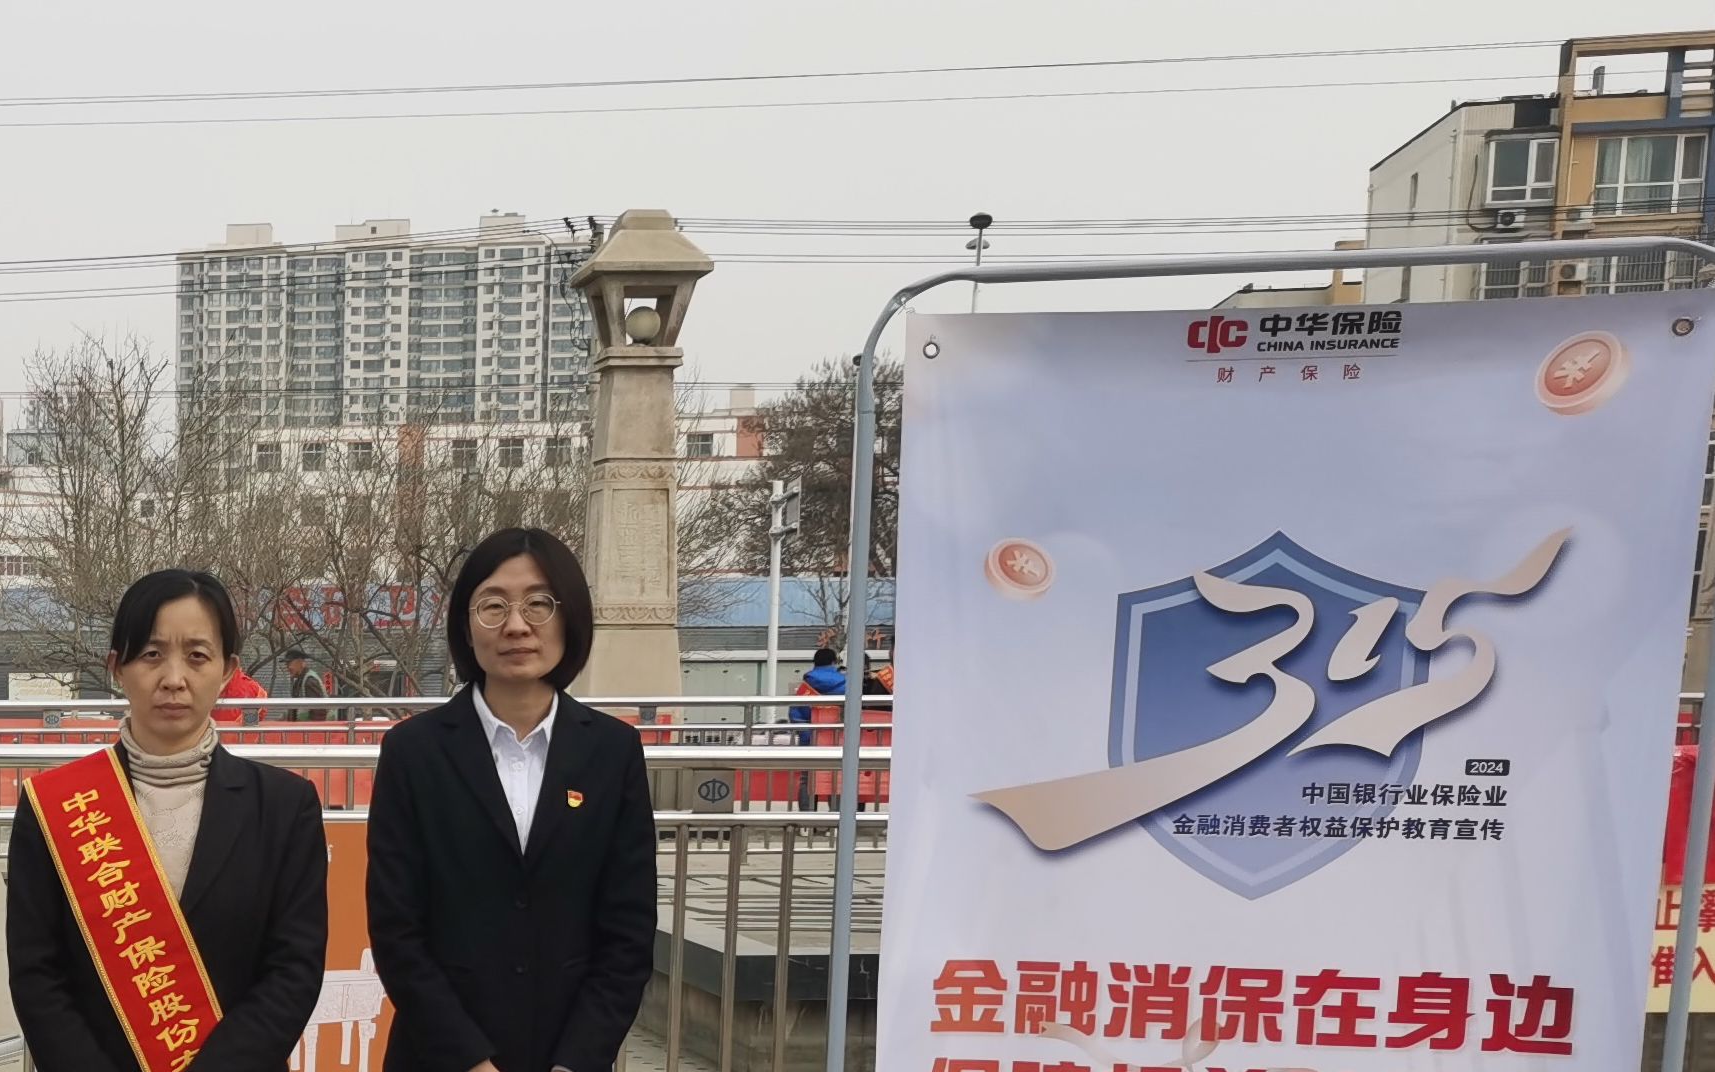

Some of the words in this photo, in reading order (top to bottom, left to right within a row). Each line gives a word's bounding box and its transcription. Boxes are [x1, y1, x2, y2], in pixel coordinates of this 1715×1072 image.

[1259, 310, 1403, 337] 中华保险
[1256, 340, 1304, 351] CHINA
[1309, 338, 1399, 350] INSURANCE
[1216, 362, 1360, 383] 财产保险
[1469, 761, 1503, 773] 2024
[1301, 782, 1506, 806] 中国银行业保险业
[1171, 812, 1505, 841] 金融消费者权益保护教育宣传
[929, 959, 1574, 1056] 金融消保在身边
